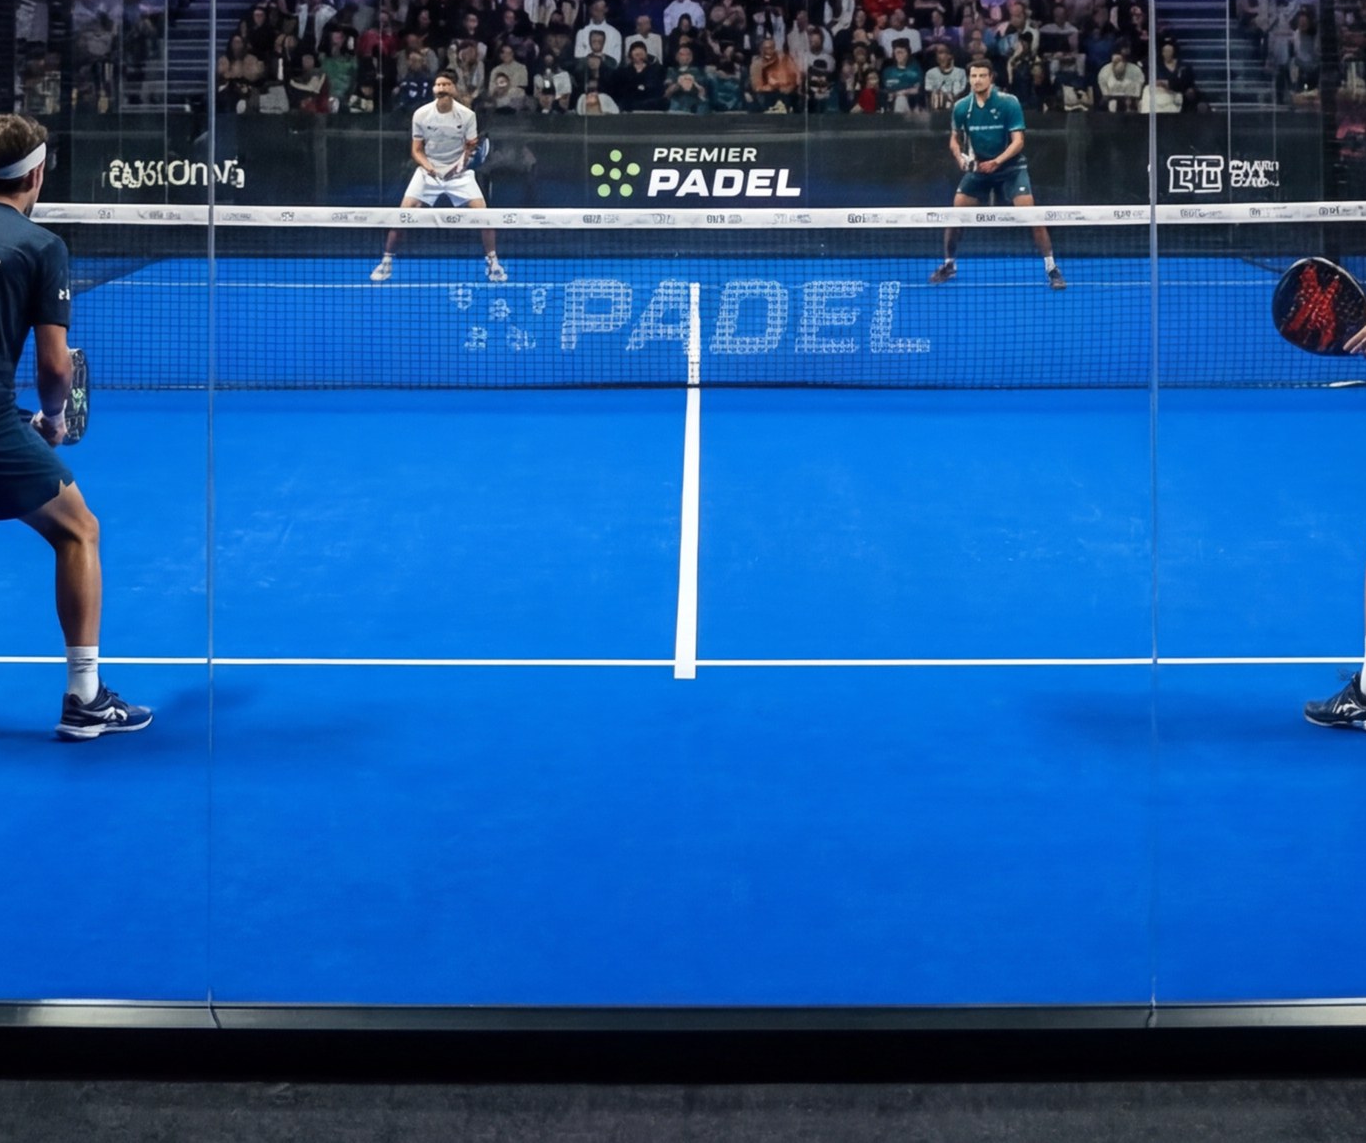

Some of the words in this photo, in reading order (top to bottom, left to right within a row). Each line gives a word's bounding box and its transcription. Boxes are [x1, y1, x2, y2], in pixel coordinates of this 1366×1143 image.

[653, 148, 757, 162] PREMIER
[647, 169, 801, 197] PADEL
[561, 279, 930, 354] PADEL
